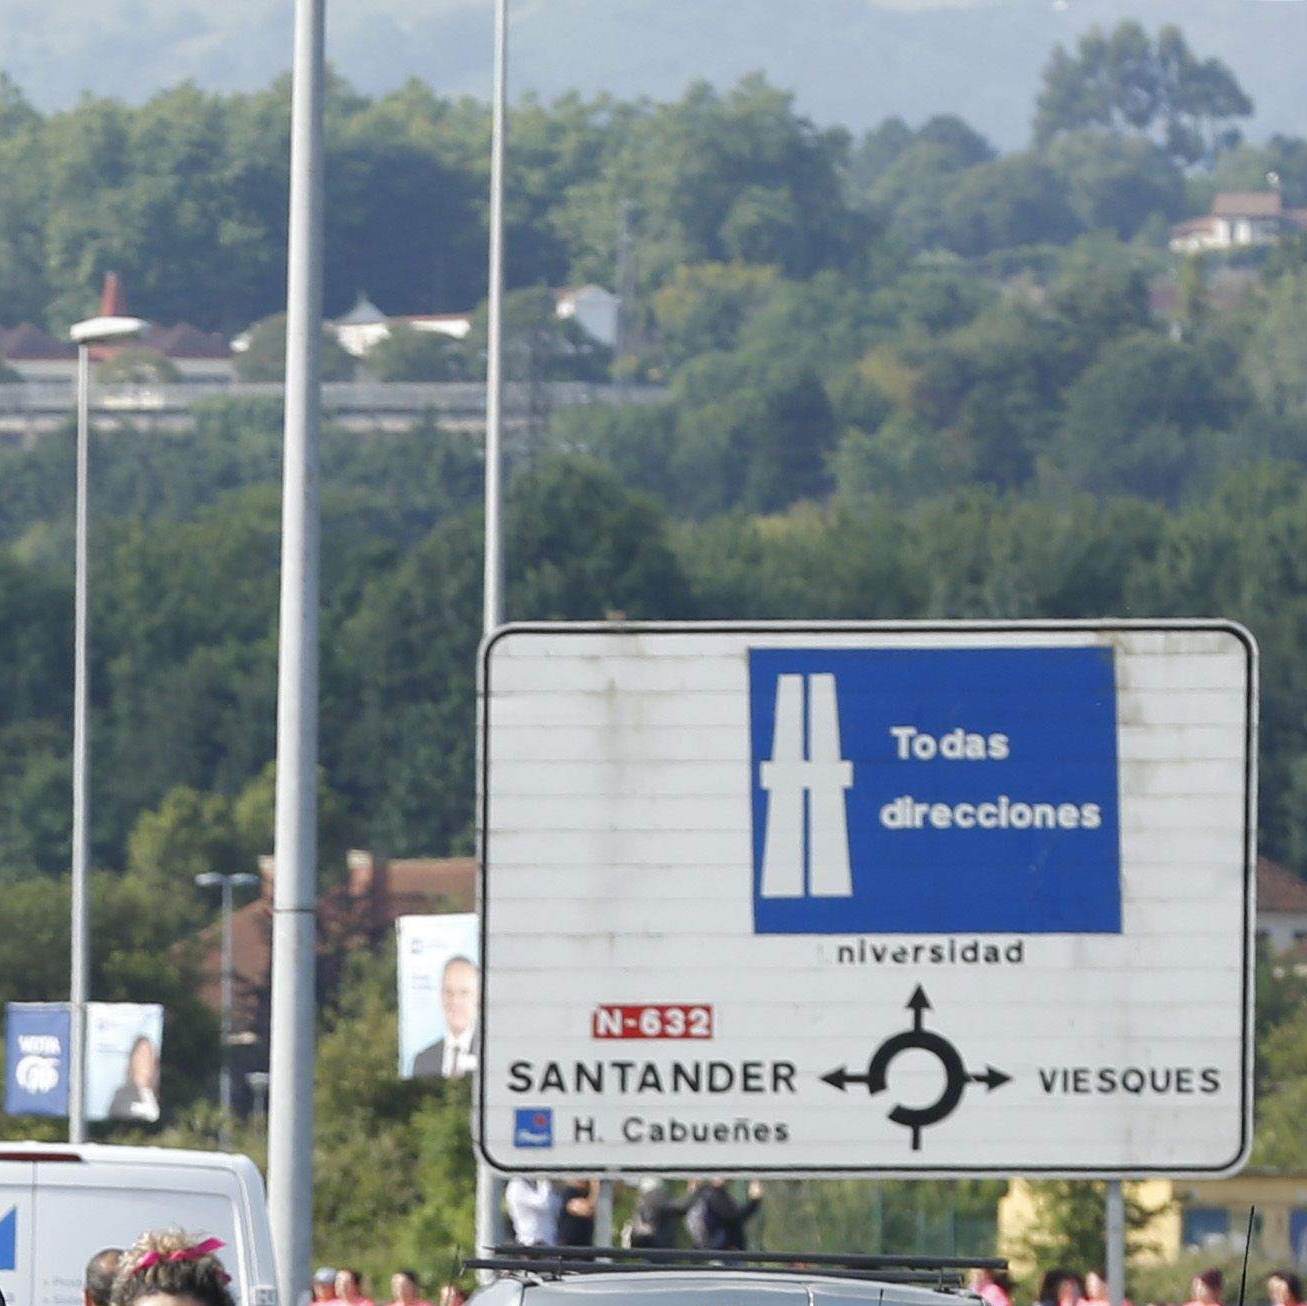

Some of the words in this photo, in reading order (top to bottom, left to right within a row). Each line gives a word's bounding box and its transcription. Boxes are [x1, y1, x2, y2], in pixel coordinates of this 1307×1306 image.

[890, 726, 1010, 760] Todas
[880, 796, 1101, 829] direcciones
[596, 1007, 711, 1037] N-632
[508, 1060, 797, 1094] SANTANDER
[1039, 1068, 1221, 1096] VIESQUES
[573, 1117, 604, 1143] H.
[623, 1116, 789, 1143] Cabueñes
